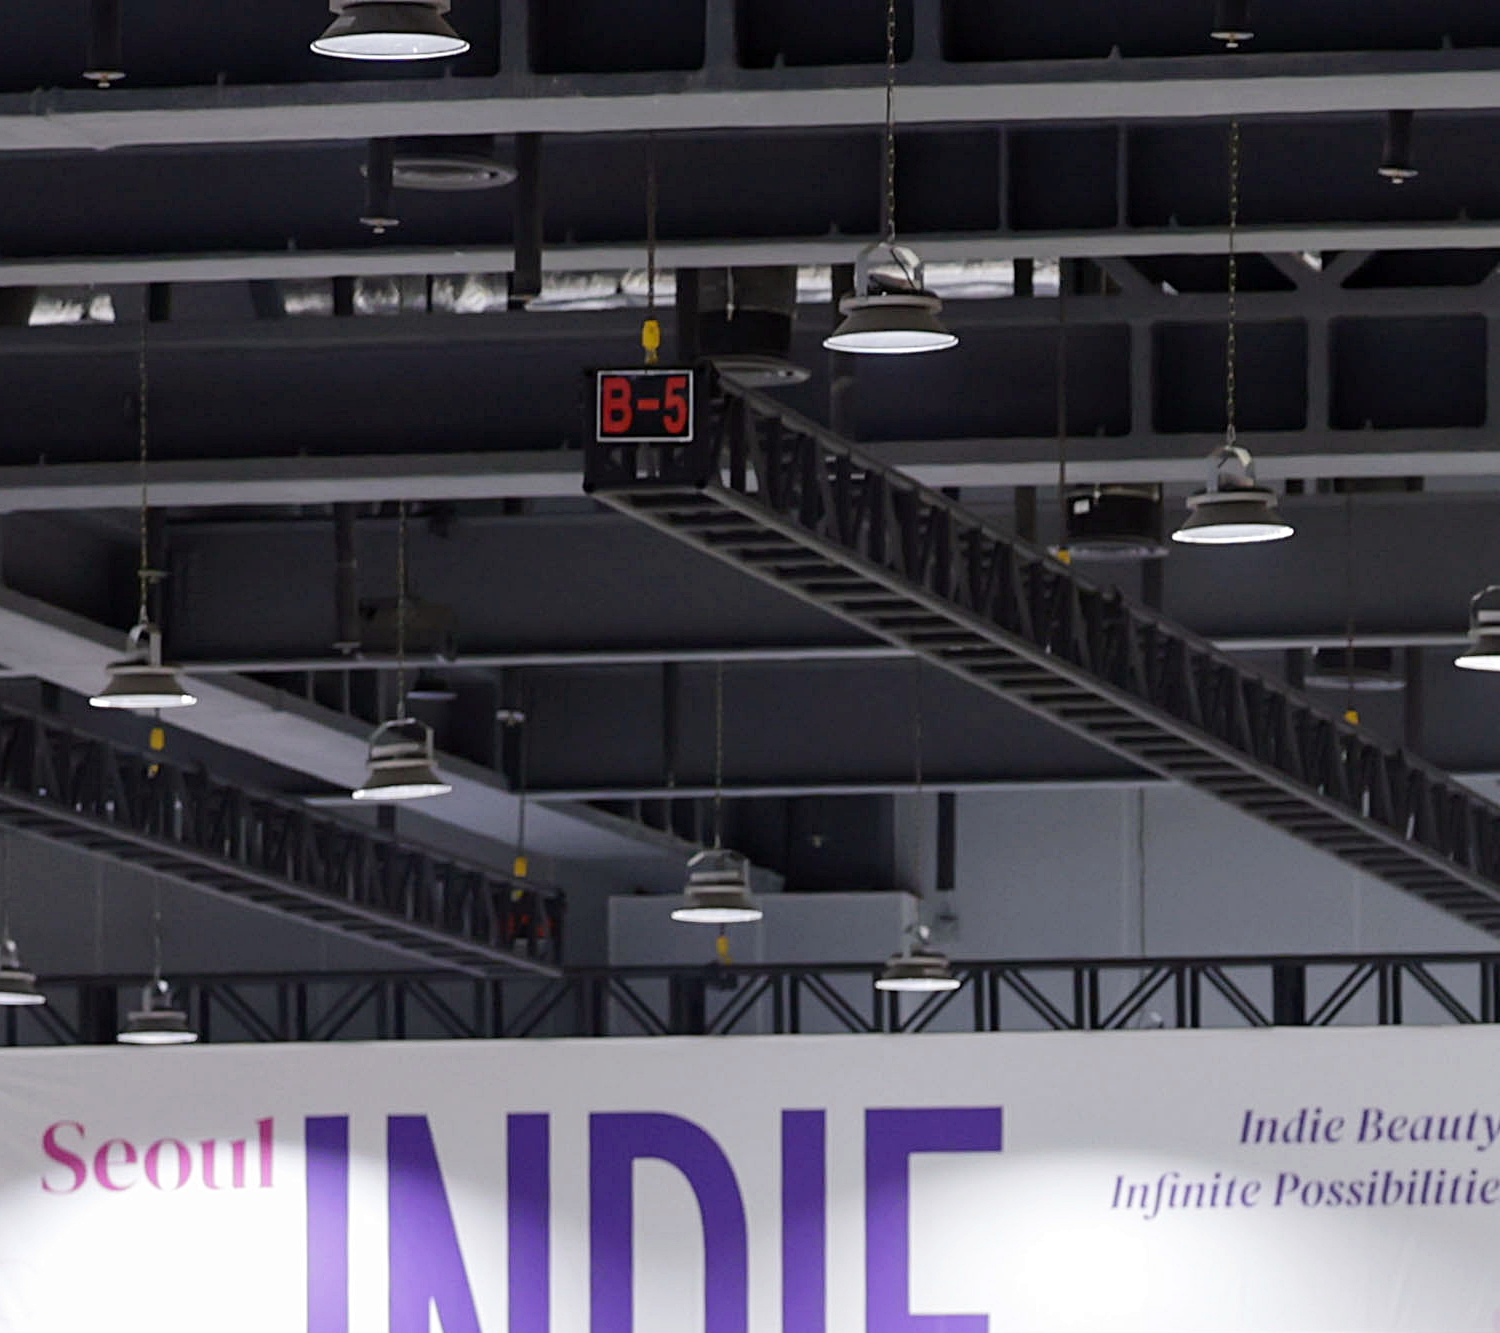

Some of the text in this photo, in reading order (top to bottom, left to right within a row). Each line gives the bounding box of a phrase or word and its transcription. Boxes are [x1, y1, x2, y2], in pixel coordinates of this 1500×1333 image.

[602, 376, 688, 435] B-5
[1238, 1106, 1344, 1145] Indie
[40, 1116, 274, 1195] Seoul
[1110, 1172, 1263, 1220] Infinite
